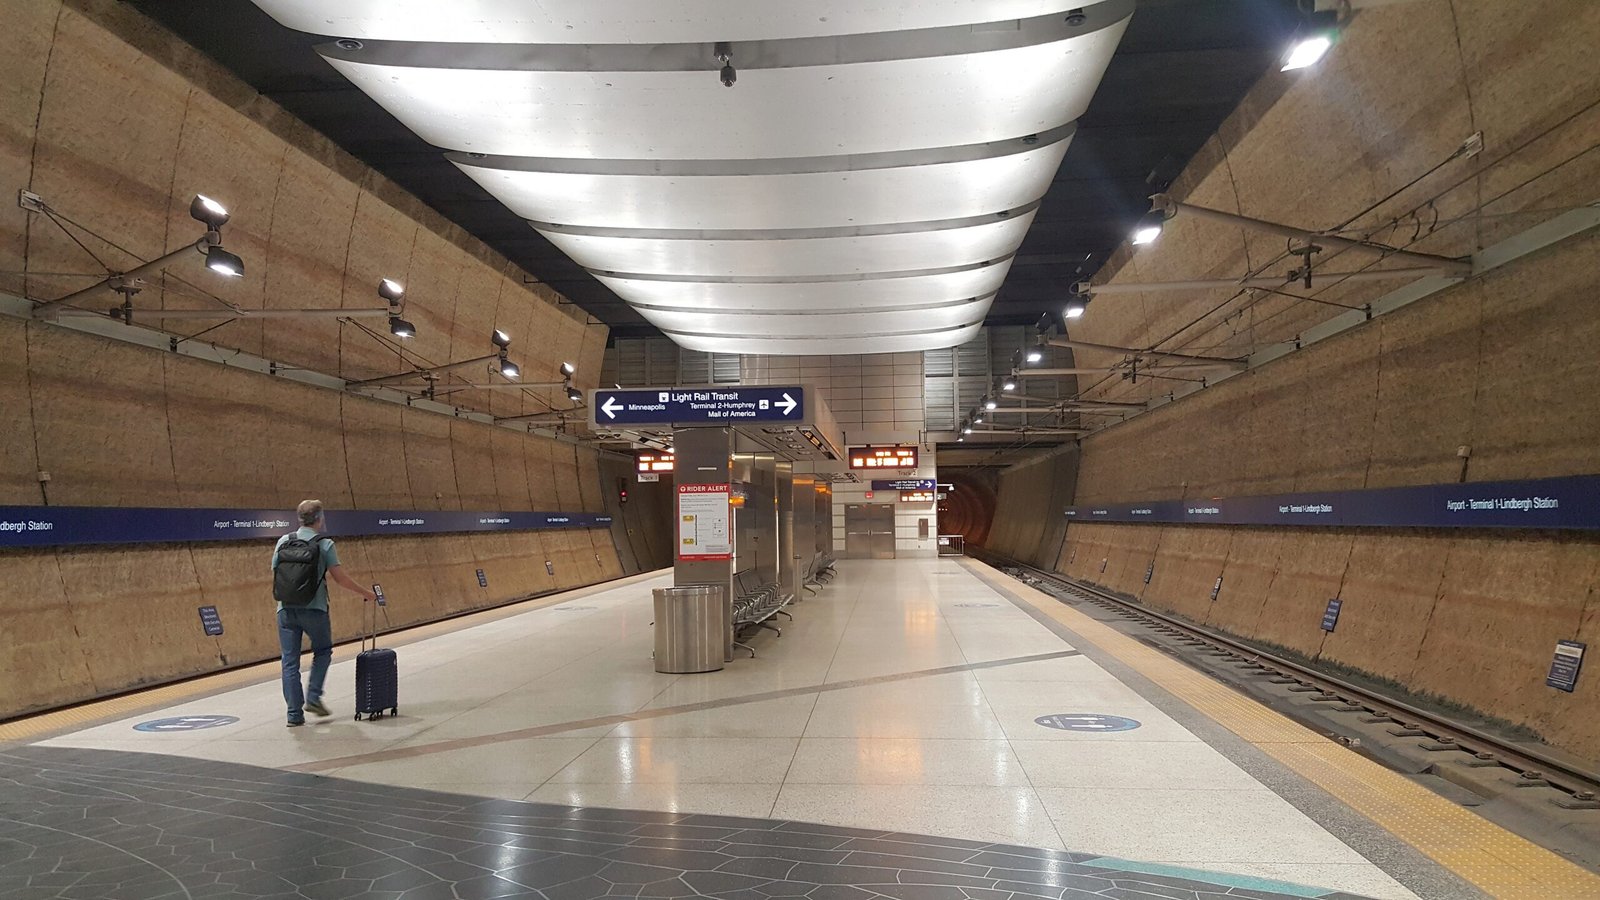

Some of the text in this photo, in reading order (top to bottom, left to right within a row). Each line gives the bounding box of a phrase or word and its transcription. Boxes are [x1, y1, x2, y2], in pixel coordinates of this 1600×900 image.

[672, 393, 692, 403] Light
[710, 392, 738, 400] Transit
[718, 402, 756, 410] 2-Humphrey
[1447, 500, 1465, 512] Airport
[1469, 499, 1494, 510] Terminal
[1495, 498, 1532, 511] 1-Lindbergh
[1533, 497, 1558, 508] Station
[27, 521, 53, 530] Station
[214, 520, 229, 529] Airport
[252, 520, 275, 529] 1-Lindbergh
